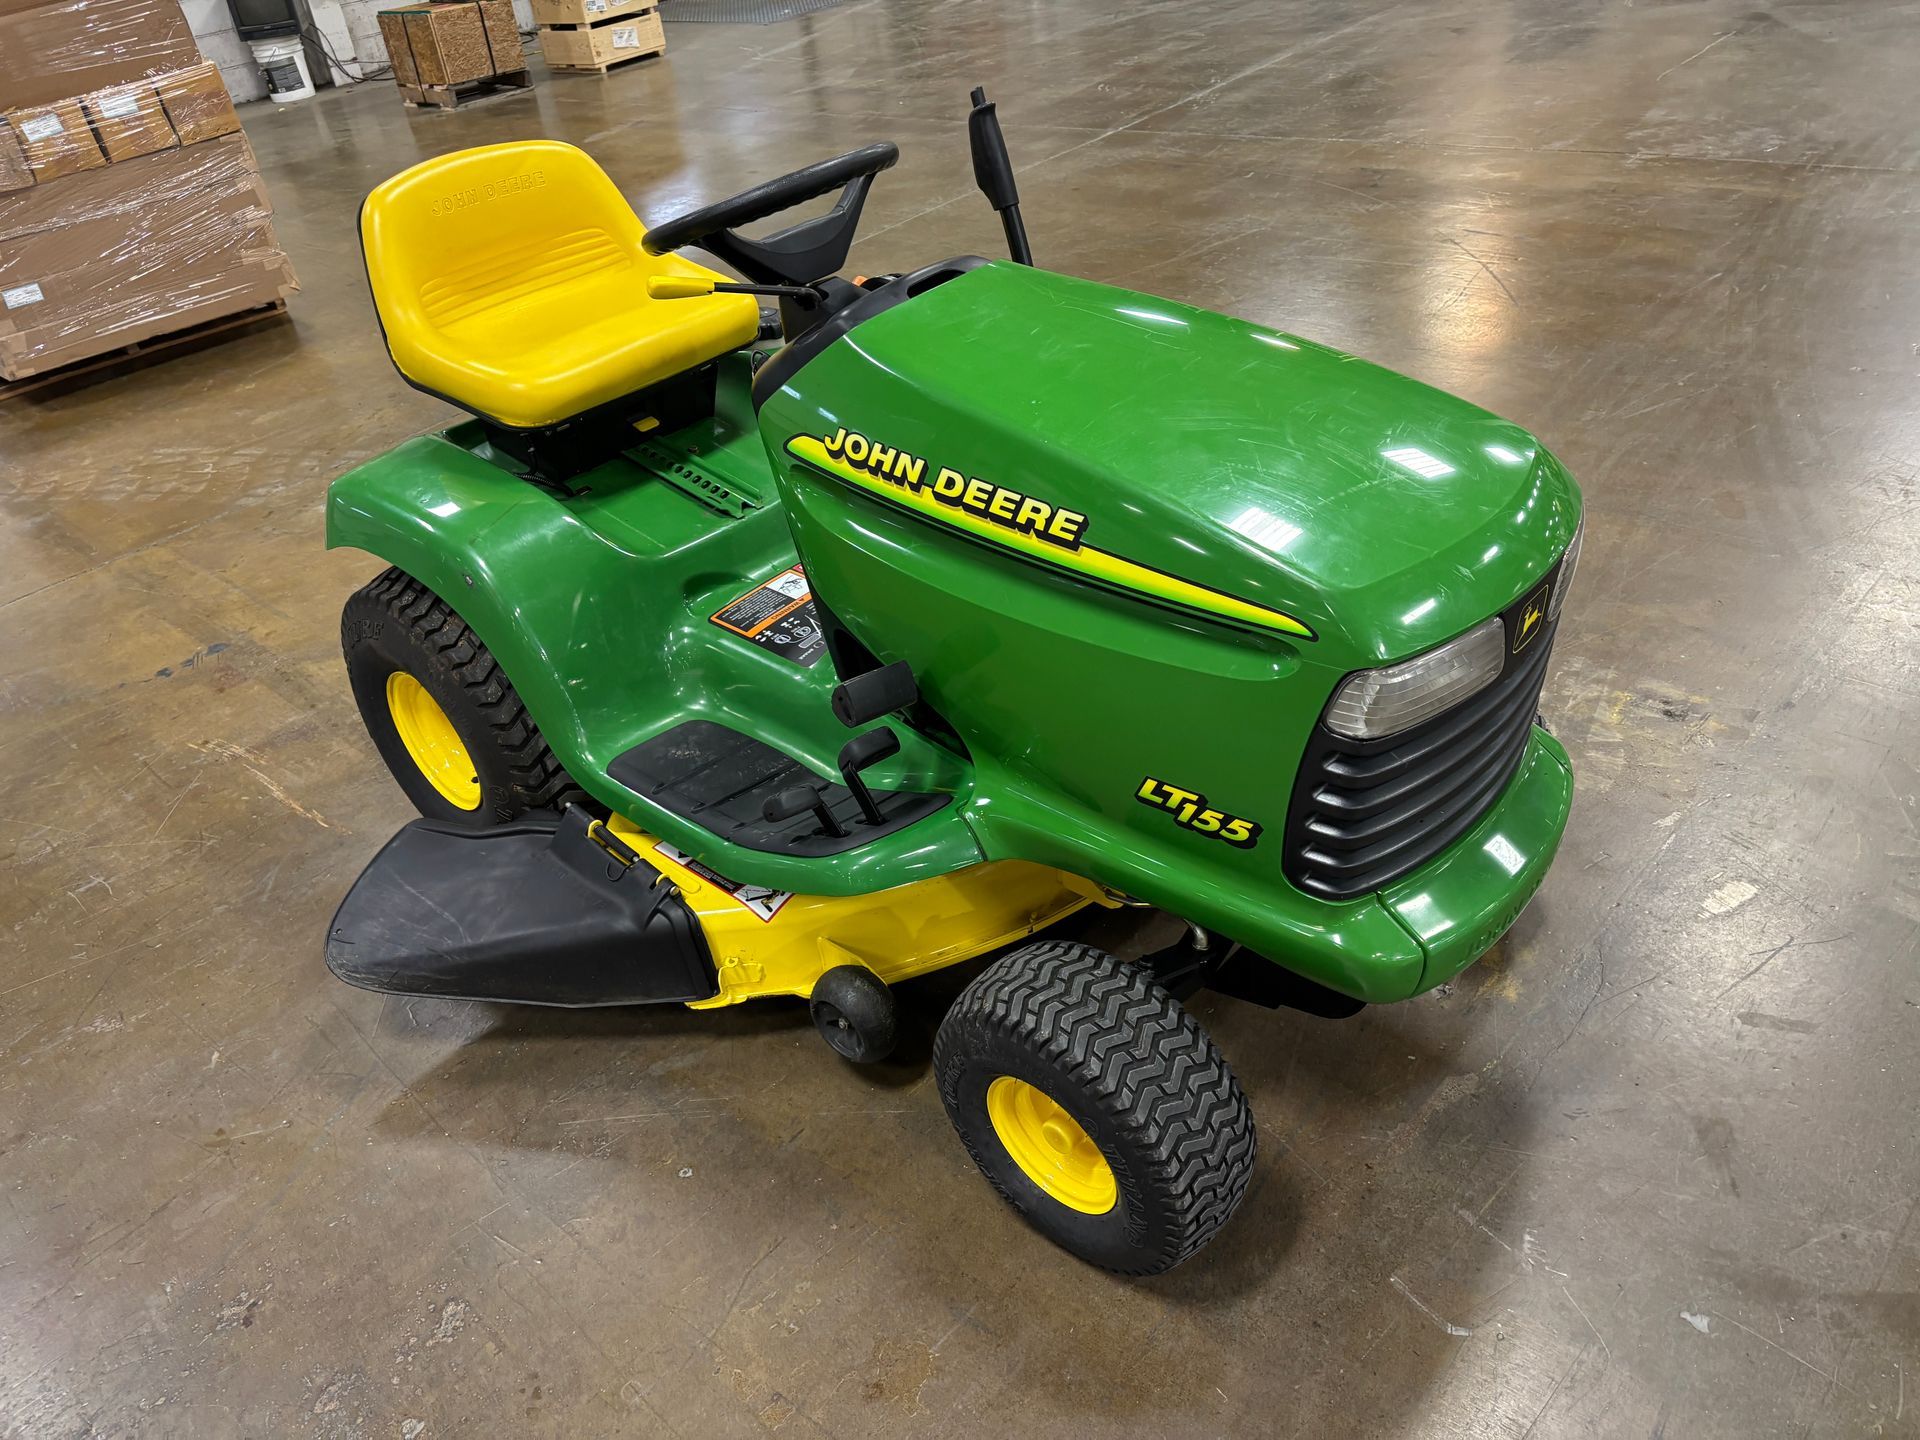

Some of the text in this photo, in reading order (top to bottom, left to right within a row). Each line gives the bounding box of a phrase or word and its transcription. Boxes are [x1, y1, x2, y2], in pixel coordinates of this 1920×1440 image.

[431, 170, 547, 216] JOHN DEERE
[823, 426, 1089, 551] JOHN DEERE
[1135, 776, 1263, 849] LT155
